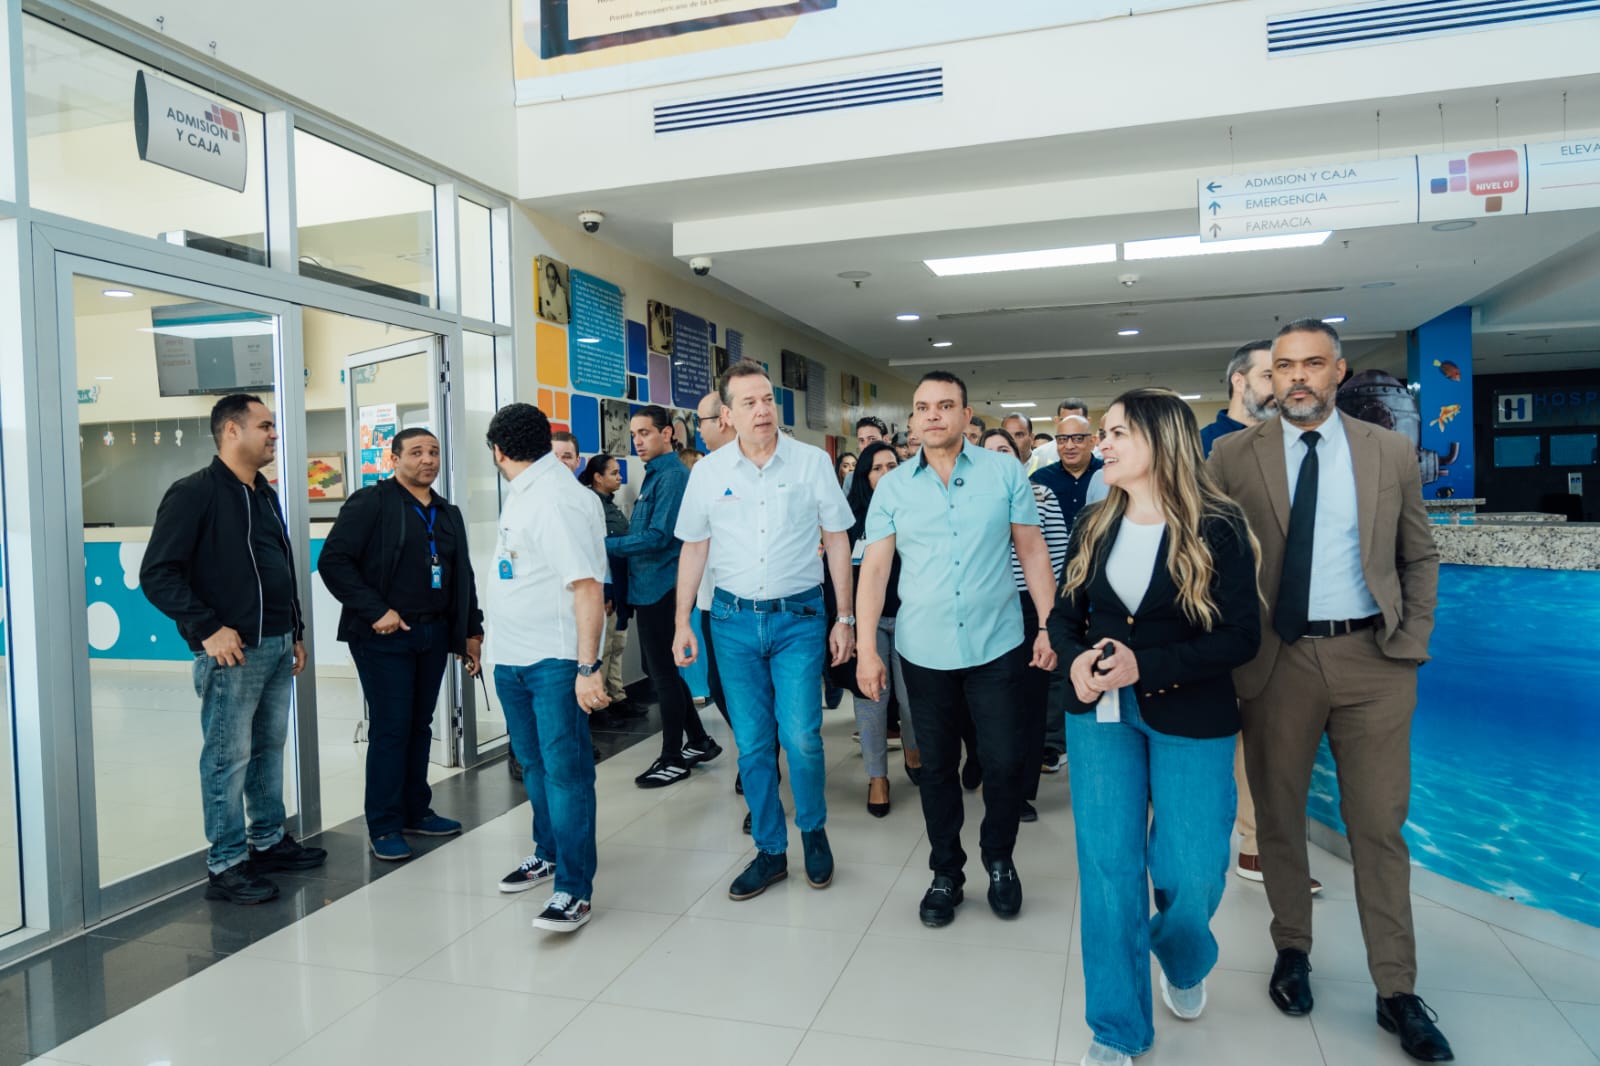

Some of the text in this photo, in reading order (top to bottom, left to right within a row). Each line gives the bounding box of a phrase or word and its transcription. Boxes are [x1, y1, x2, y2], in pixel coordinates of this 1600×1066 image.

[168, 107, 228, 140] ADMISION
[176, 128, 221, 155] Y CAJA
[1244, 168, 1357, 189] ADMISION Y CAJA
[1475, 180, 1514, 191] NIVEL 01
[1245, 192, 1328, 209] EMERGENCIA
[1245, 216, 1313, 233] FARMACIA
